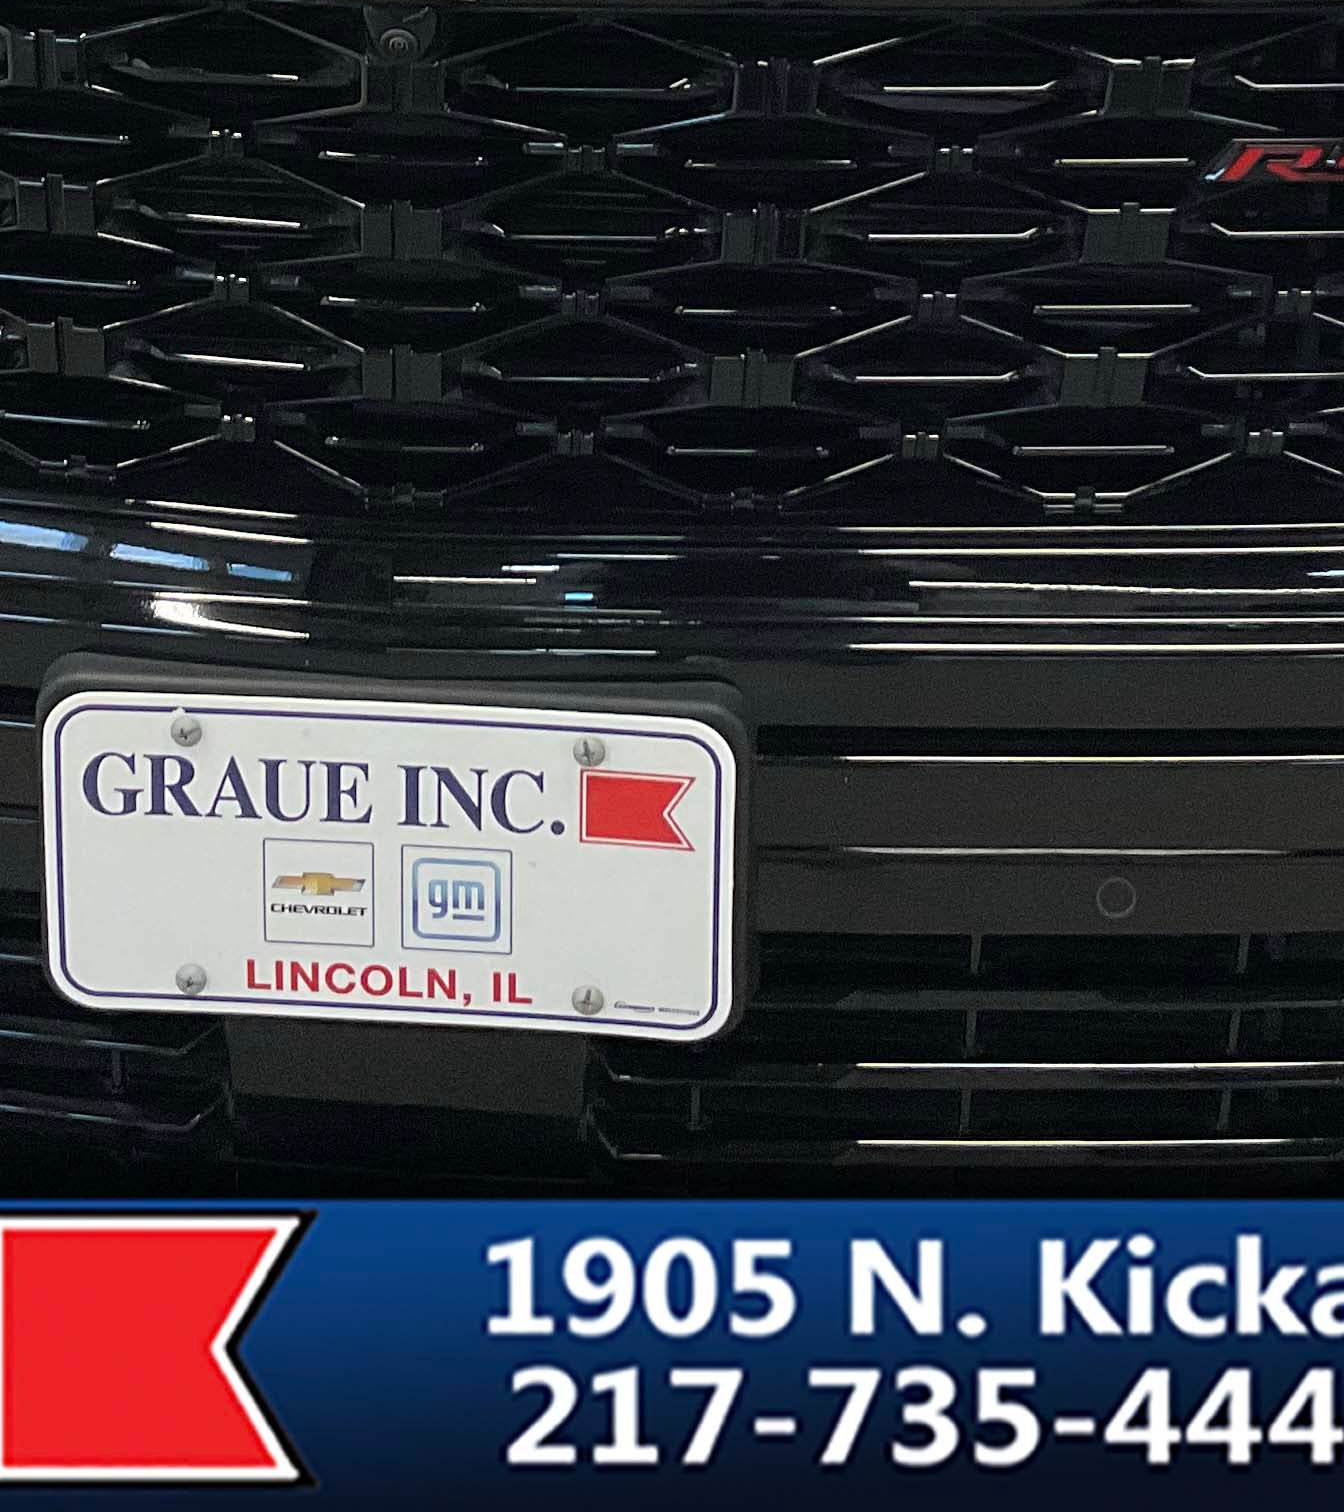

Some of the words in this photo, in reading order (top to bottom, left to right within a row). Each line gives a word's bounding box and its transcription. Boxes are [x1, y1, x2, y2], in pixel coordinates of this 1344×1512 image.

[82, 752, 373, 824] GRAUE
[397, 764, 565, 836] INC.
[269, 902, 368, 918] CHEVROLET
[427, 878, 486, 921] gm
[246, 958, 472, 1006] LINCOLN,
[492, 972, 533, 1005] IL
